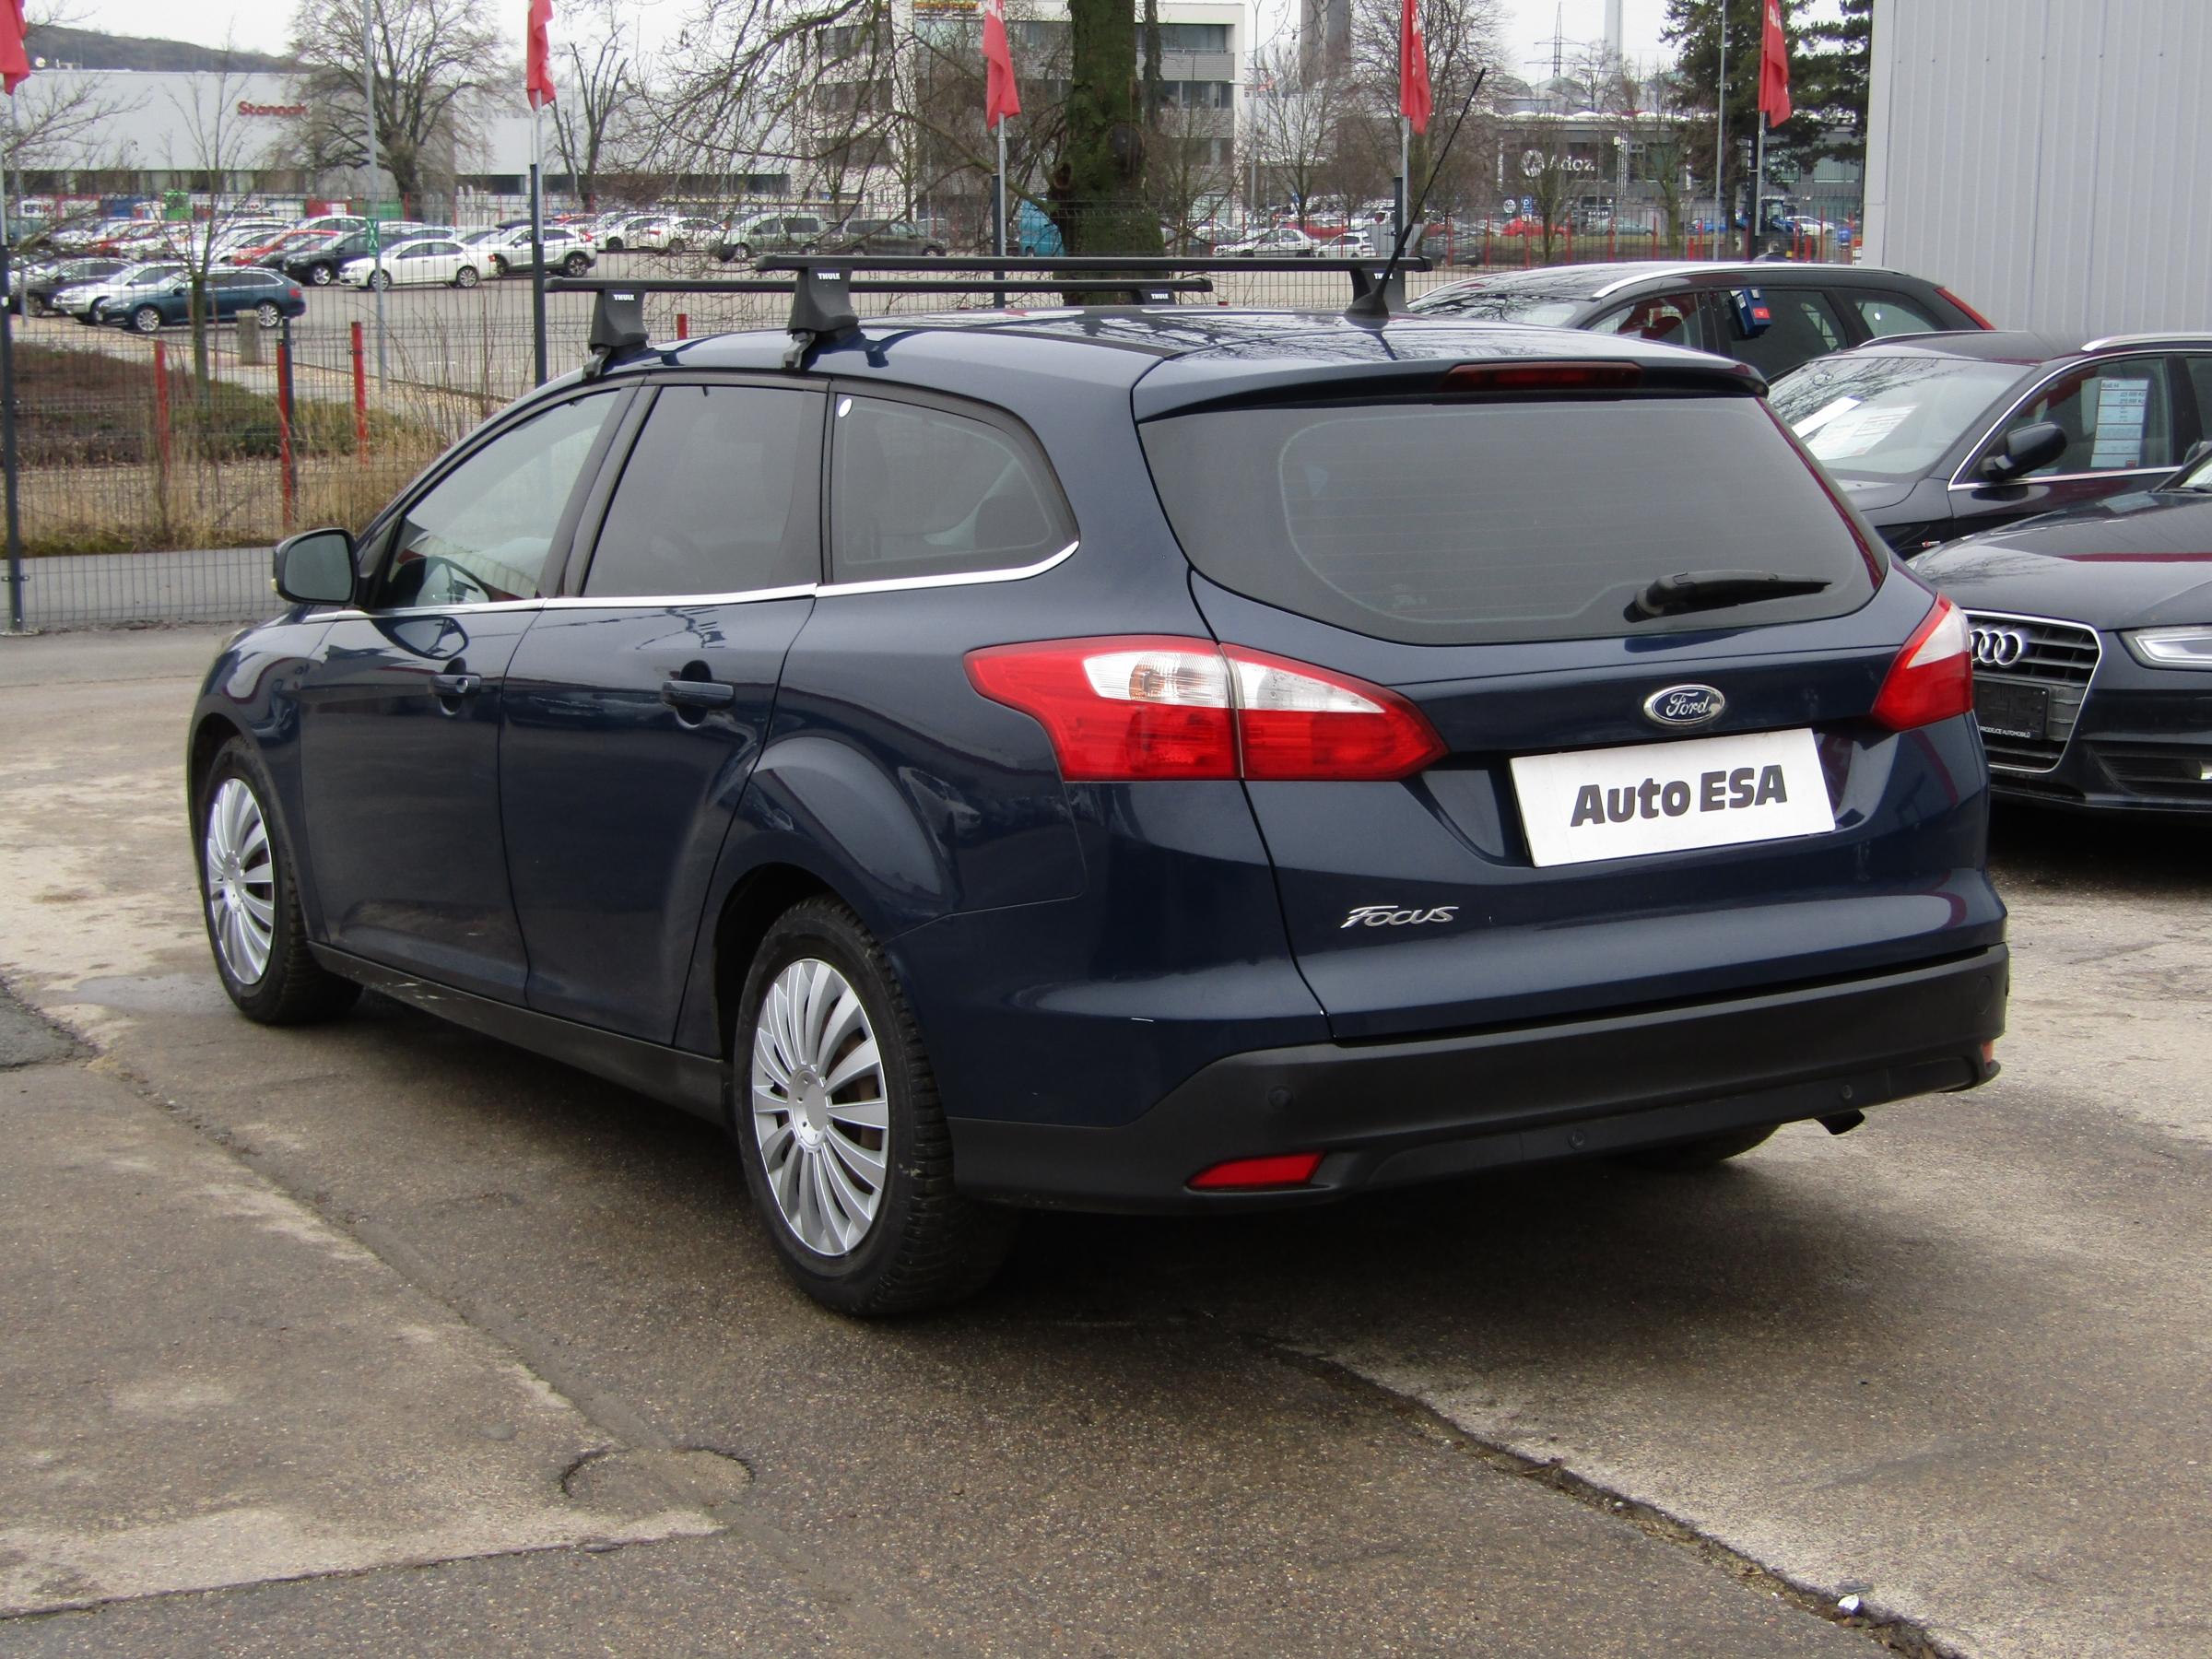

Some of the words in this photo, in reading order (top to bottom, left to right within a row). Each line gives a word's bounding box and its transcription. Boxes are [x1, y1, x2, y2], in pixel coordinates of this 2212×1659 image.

[817, 272, 841, 280] THULE
[1665, 691, 1710, 717] Ford
[1570, 781, 1691, 828] Auto
[1700, 764, 1788, 813] ESA
